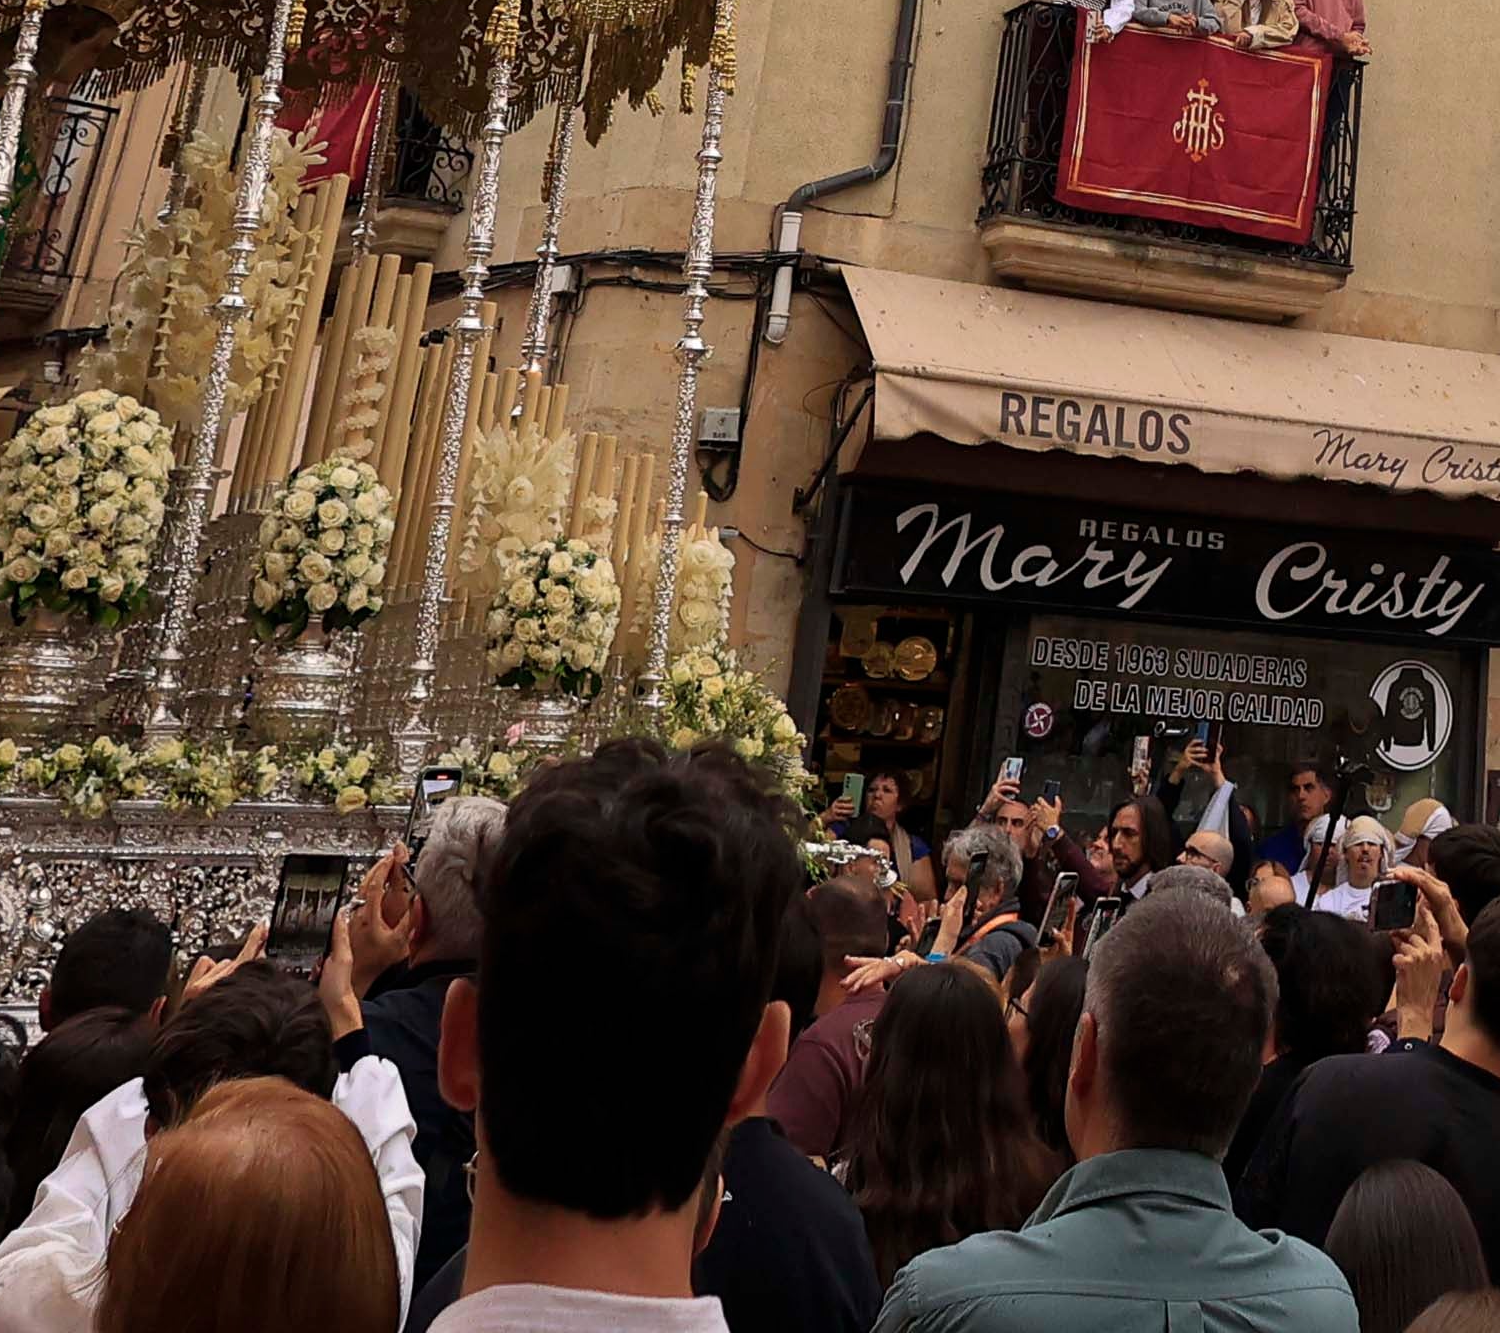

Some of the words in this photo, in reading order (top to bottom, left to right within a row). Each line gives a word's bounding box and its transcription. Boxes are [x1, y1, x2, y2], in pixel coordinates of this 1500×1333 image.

[1000, 391, 1192, 455] REGALOS
[1313, 429, 1409, 491] Mary
[1079, 518, 1225, 550] REGALOS
[896, 503, 1173, 610] Mary
[1255, 541, 1485, 636] Cristy
[1031, 636, 1109, 672] DESDE
[1115, 644, 1168, 677] 1963
[1173, 649, 1308, 688] SUDADERAS
[1074, 679, 1107, 712] DE
[1110, 683, 1140, 714] LA
[1145, 686, 1224, 721] MEJOR
[1228, 692, 1324, 728] CALIDAD
